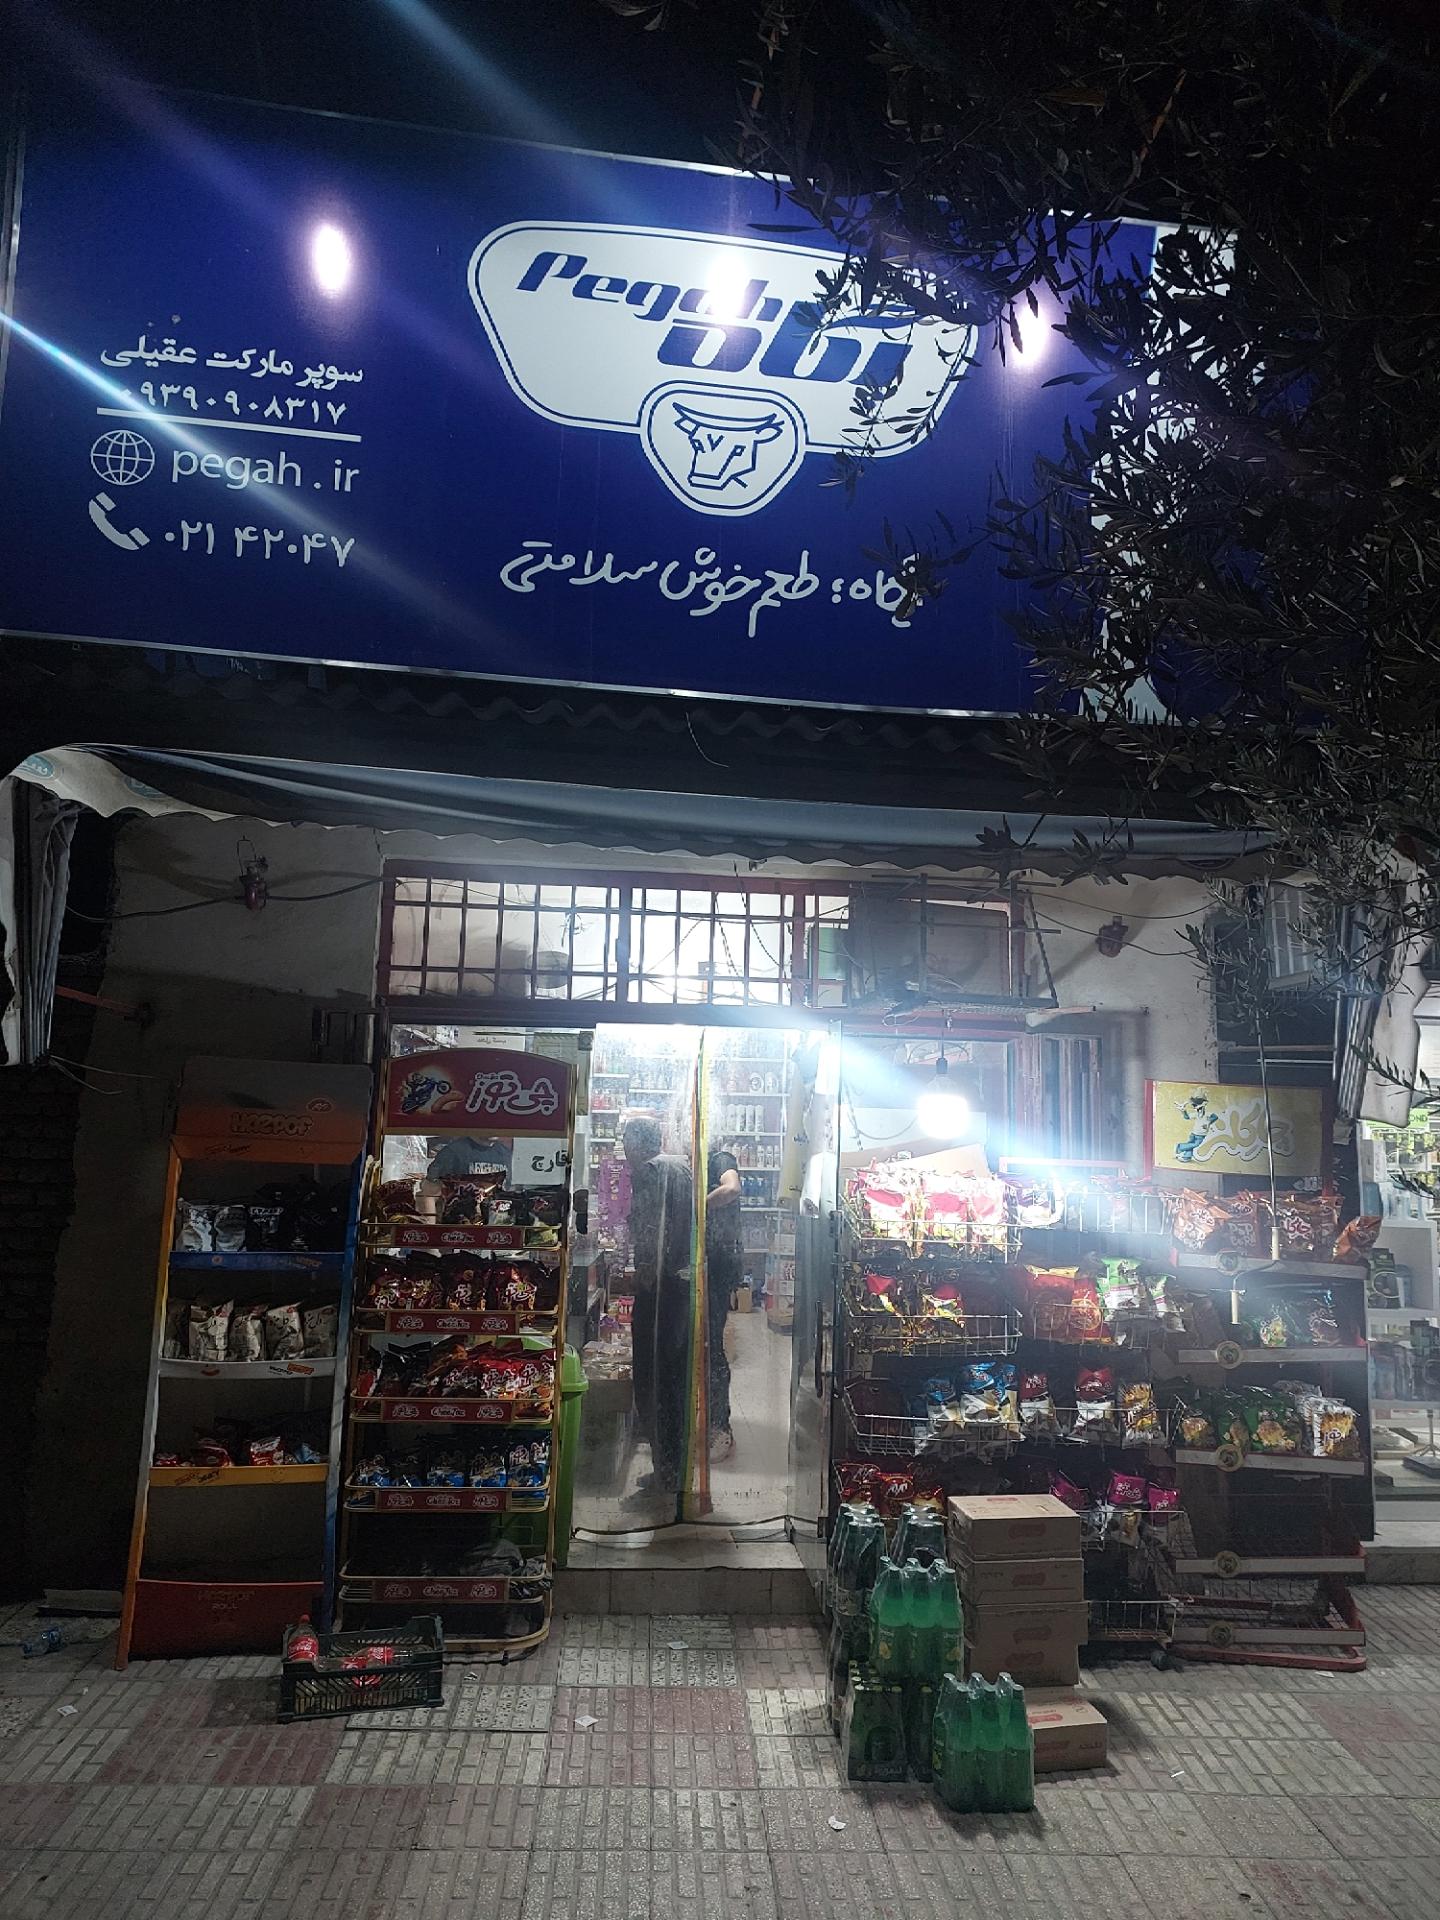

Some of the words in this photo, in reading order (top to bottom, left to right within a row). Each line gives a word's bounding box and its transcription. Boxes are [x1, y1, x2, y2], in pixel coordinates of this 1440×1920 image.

[516, 250, 783, 323] Pegah
[100, 335, 197, 369] عقیلی
[205, 346, 294, 377] مارکت
[296, 364, 364, 390] سوپر
[164, 519, 216, 555] ۰۲۱
[500, 540, 659, 594] سلامتی
